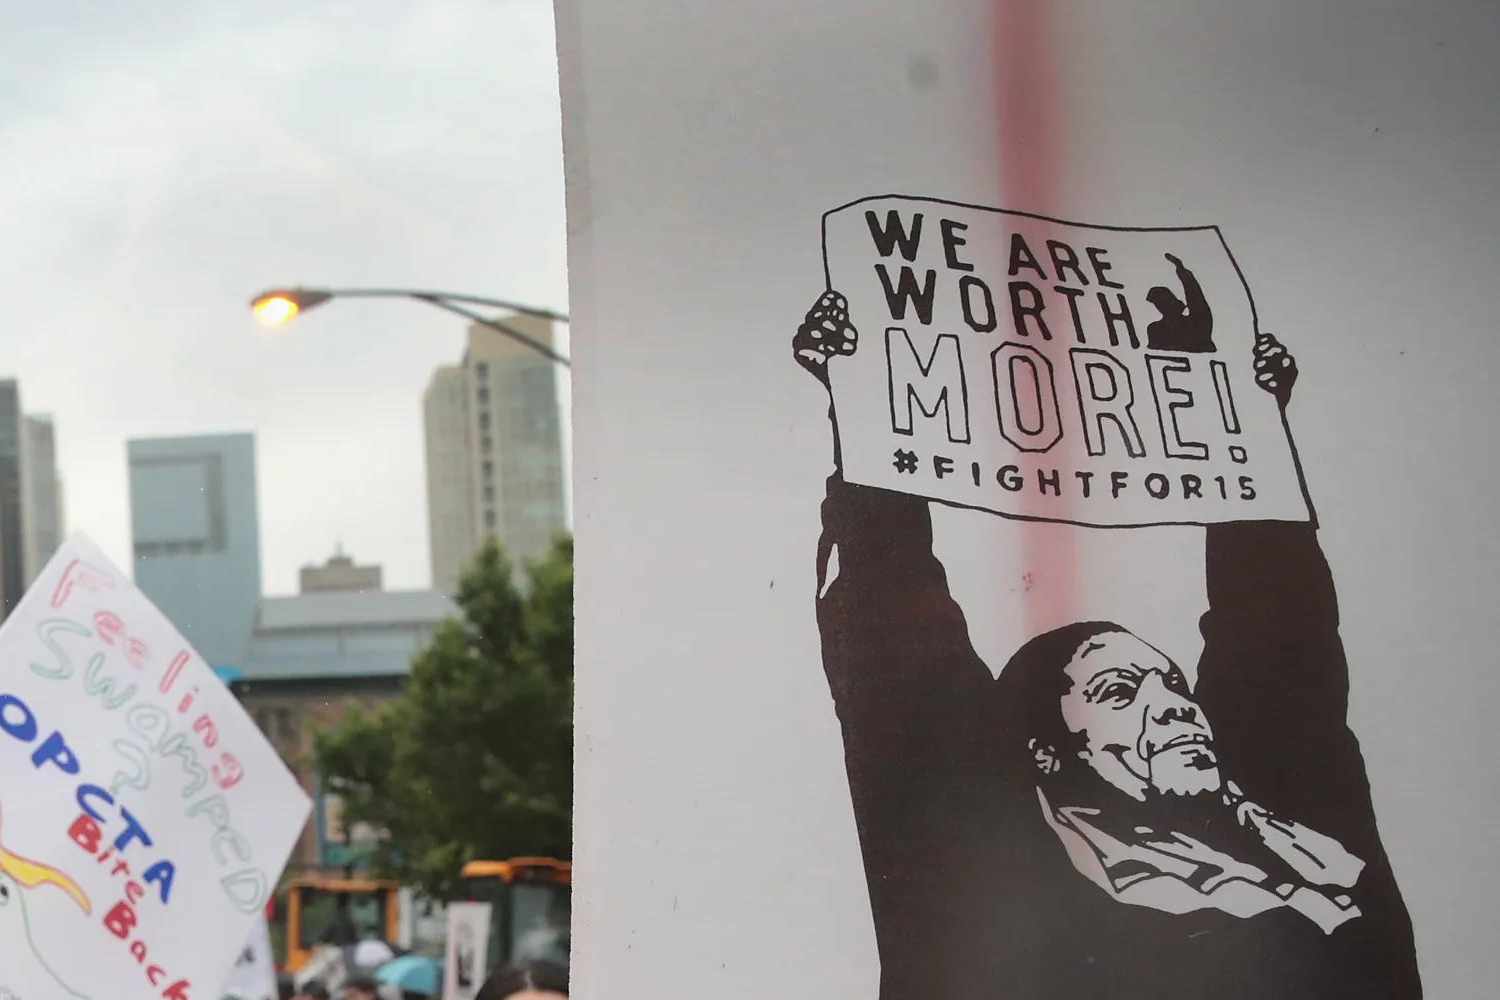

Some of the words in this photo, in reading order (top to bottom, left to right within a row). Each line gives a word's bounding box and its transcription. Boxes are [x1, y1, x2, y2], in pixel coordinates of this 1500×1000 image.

[865, 209, 974, 272] WE
[1007, 233, 1125, 290] ARE
[875, 264, 1141, 350] WORTH
[885, 327, 1249, 465] MORE!
[891, 448, 1258, 501] #FIGHTFOR15
